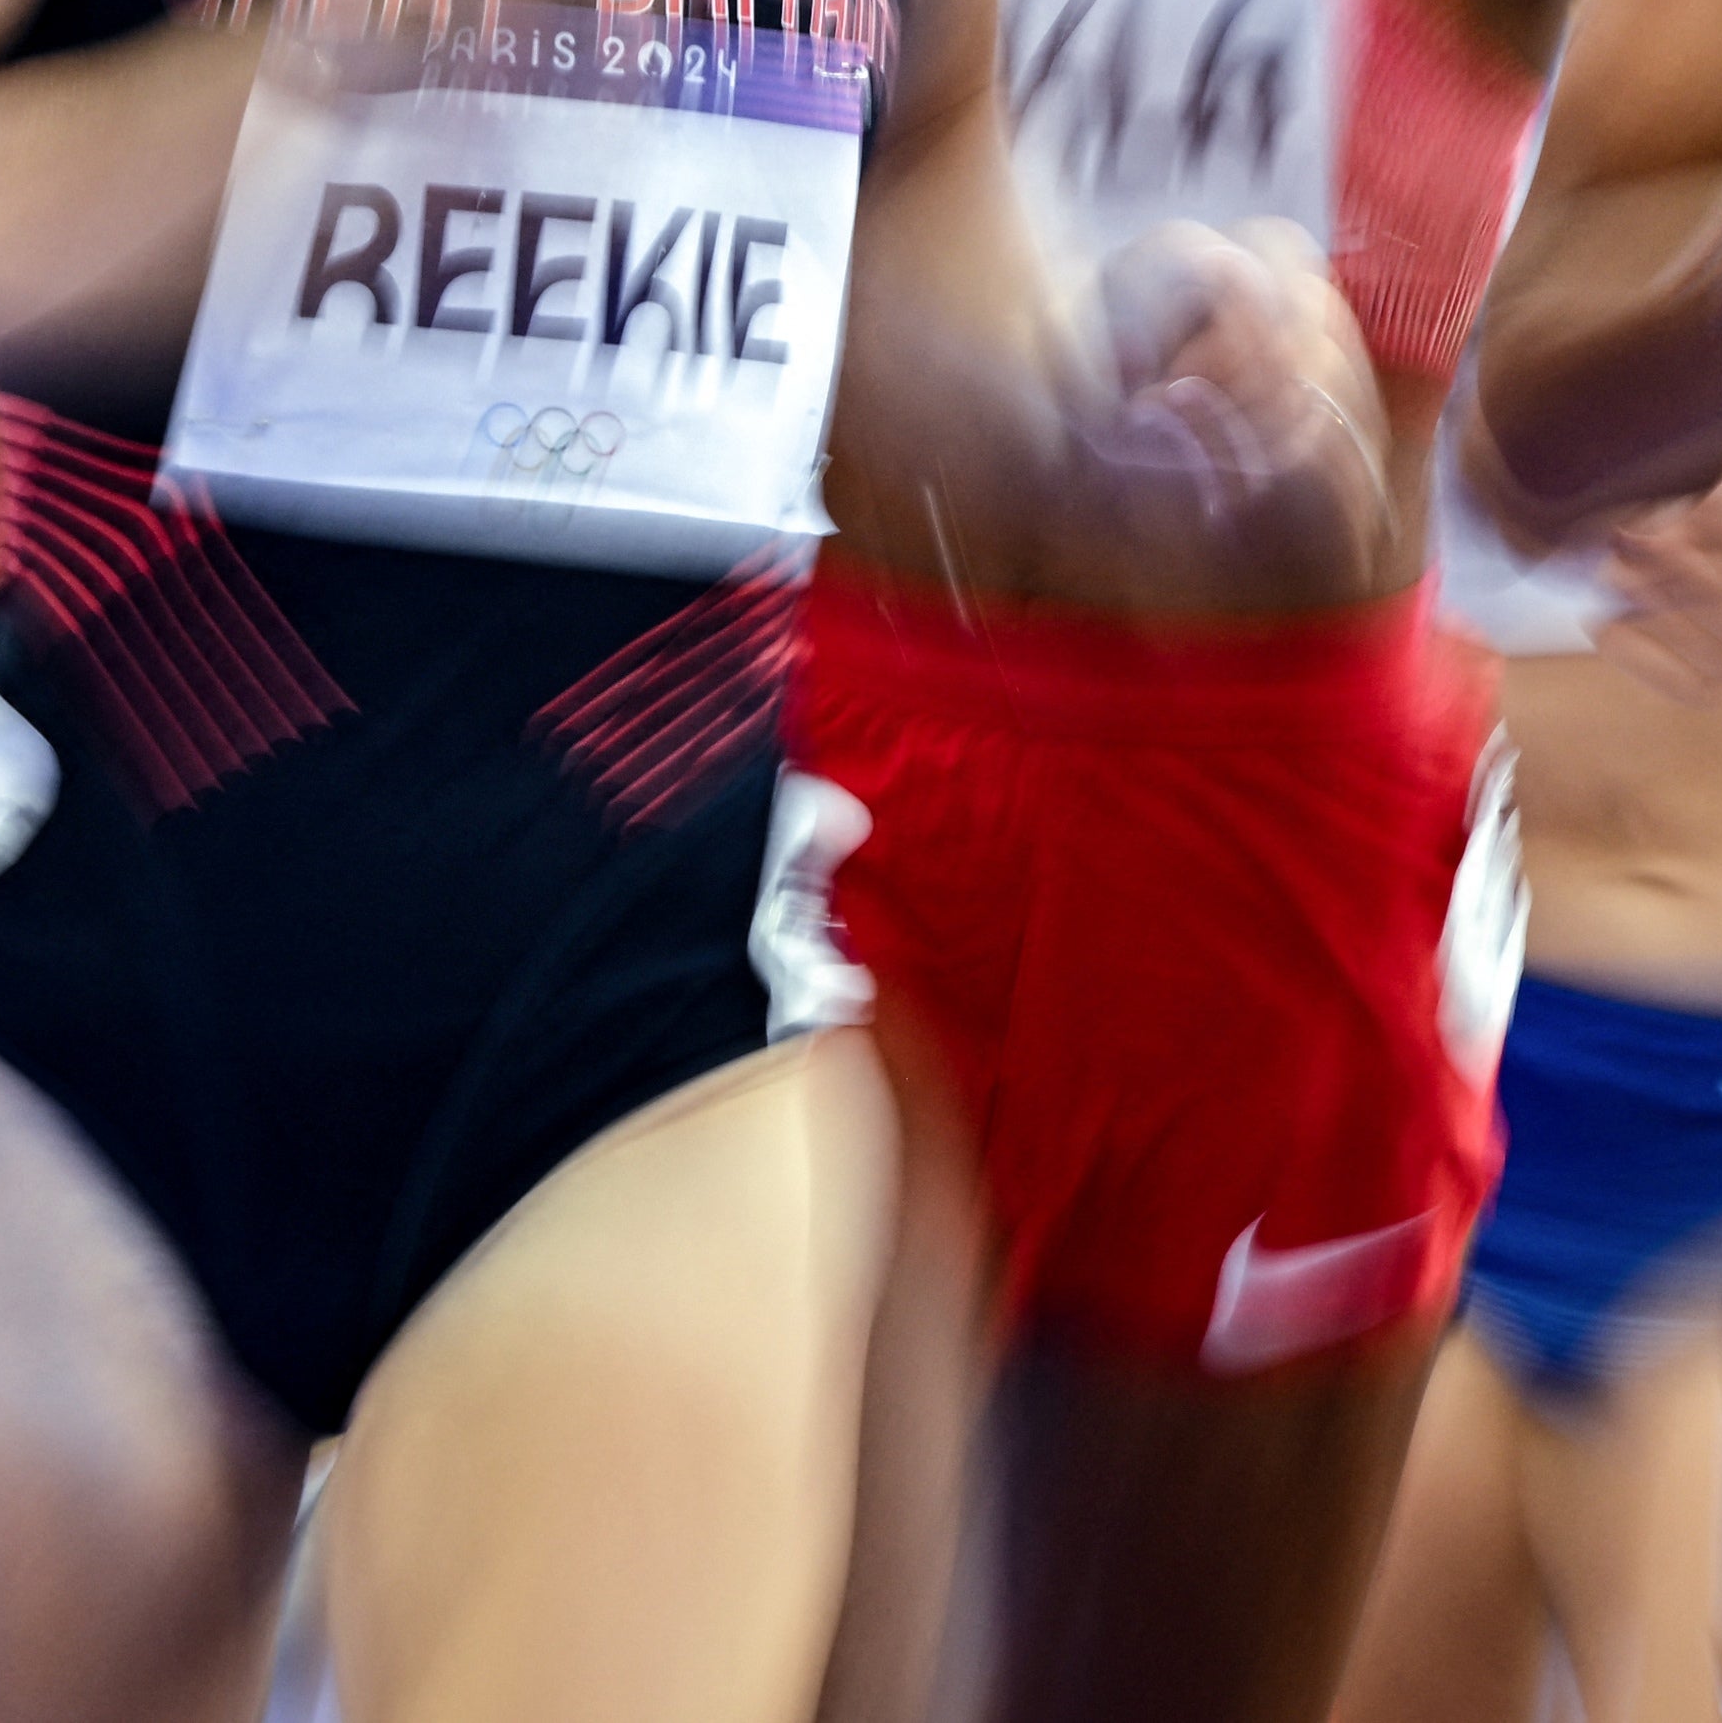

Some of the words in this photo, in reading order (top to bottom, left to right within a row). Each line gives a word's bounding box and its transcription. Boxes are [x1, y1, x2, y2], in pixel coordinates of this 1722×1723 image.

[423, 26, 579, 75] PARIS
[601, 30, 740, 90] 2024
[299, 182, 791, 368] REEKIE
